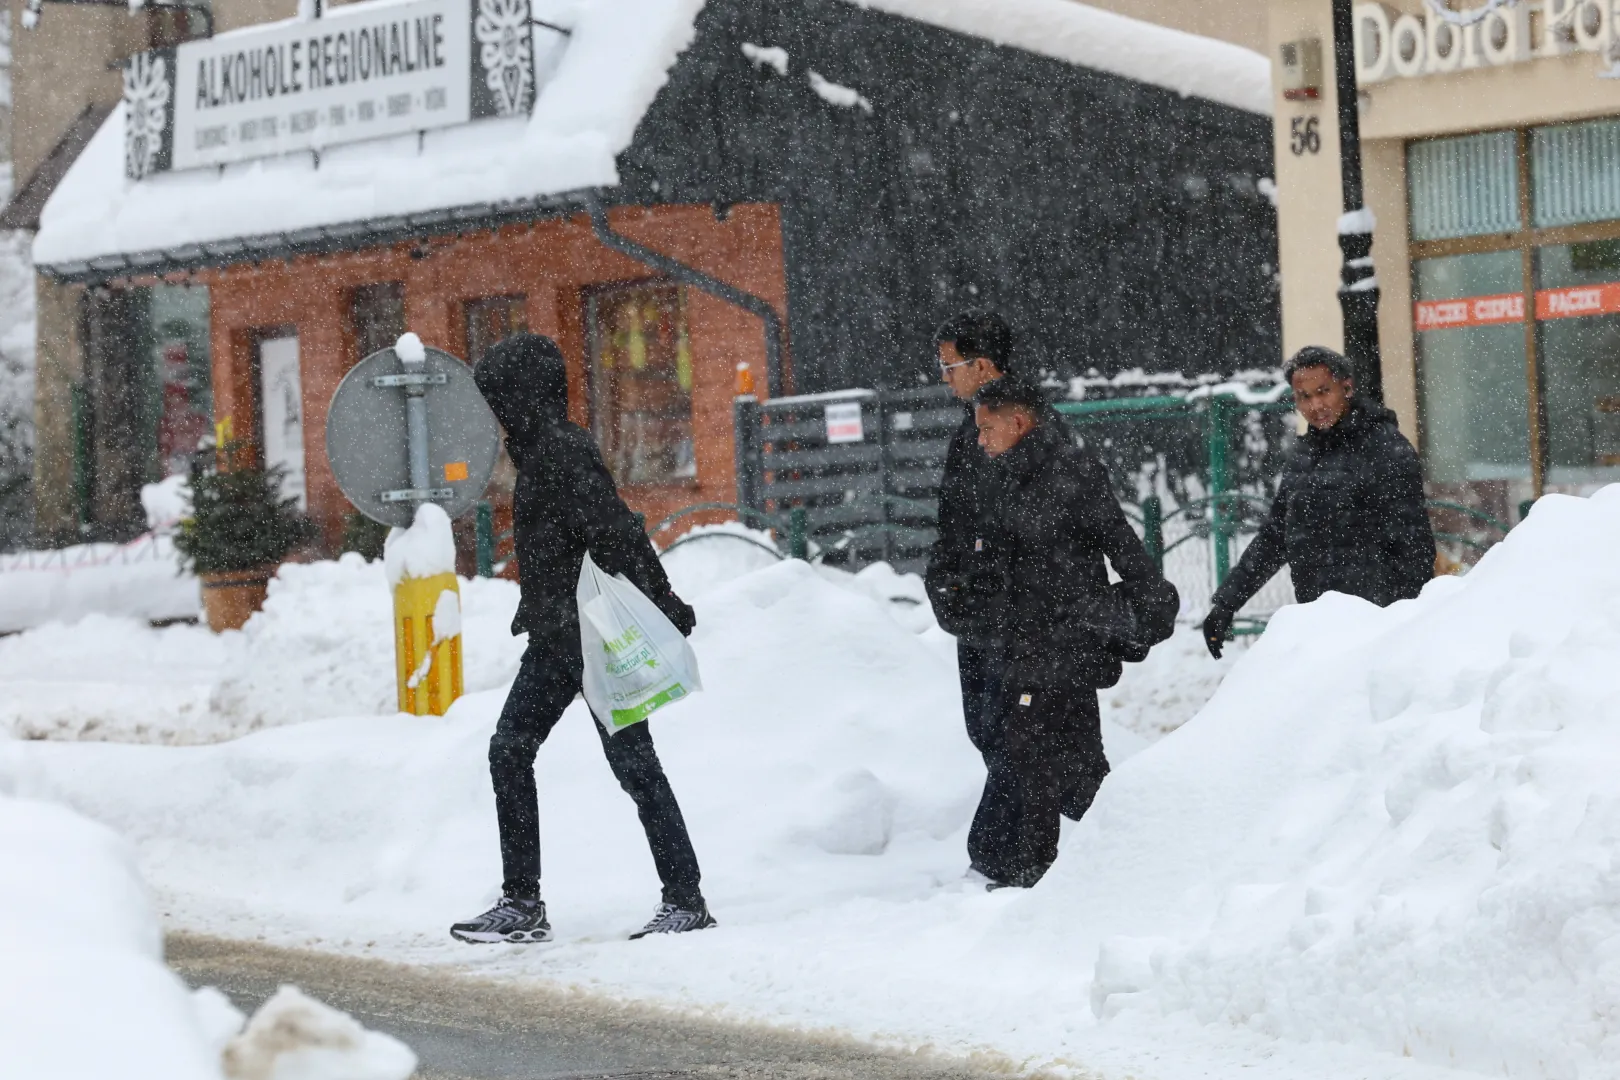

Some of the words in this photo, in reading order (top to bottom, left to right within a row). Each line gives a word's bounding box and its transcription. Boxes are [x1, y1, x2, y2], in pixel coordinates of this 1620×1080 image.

[195, 42, 302, 110] ALKOHOLE
[308, 14, 445, 90] REGIONALNE
[1290, 114, 1321, 157] 56
